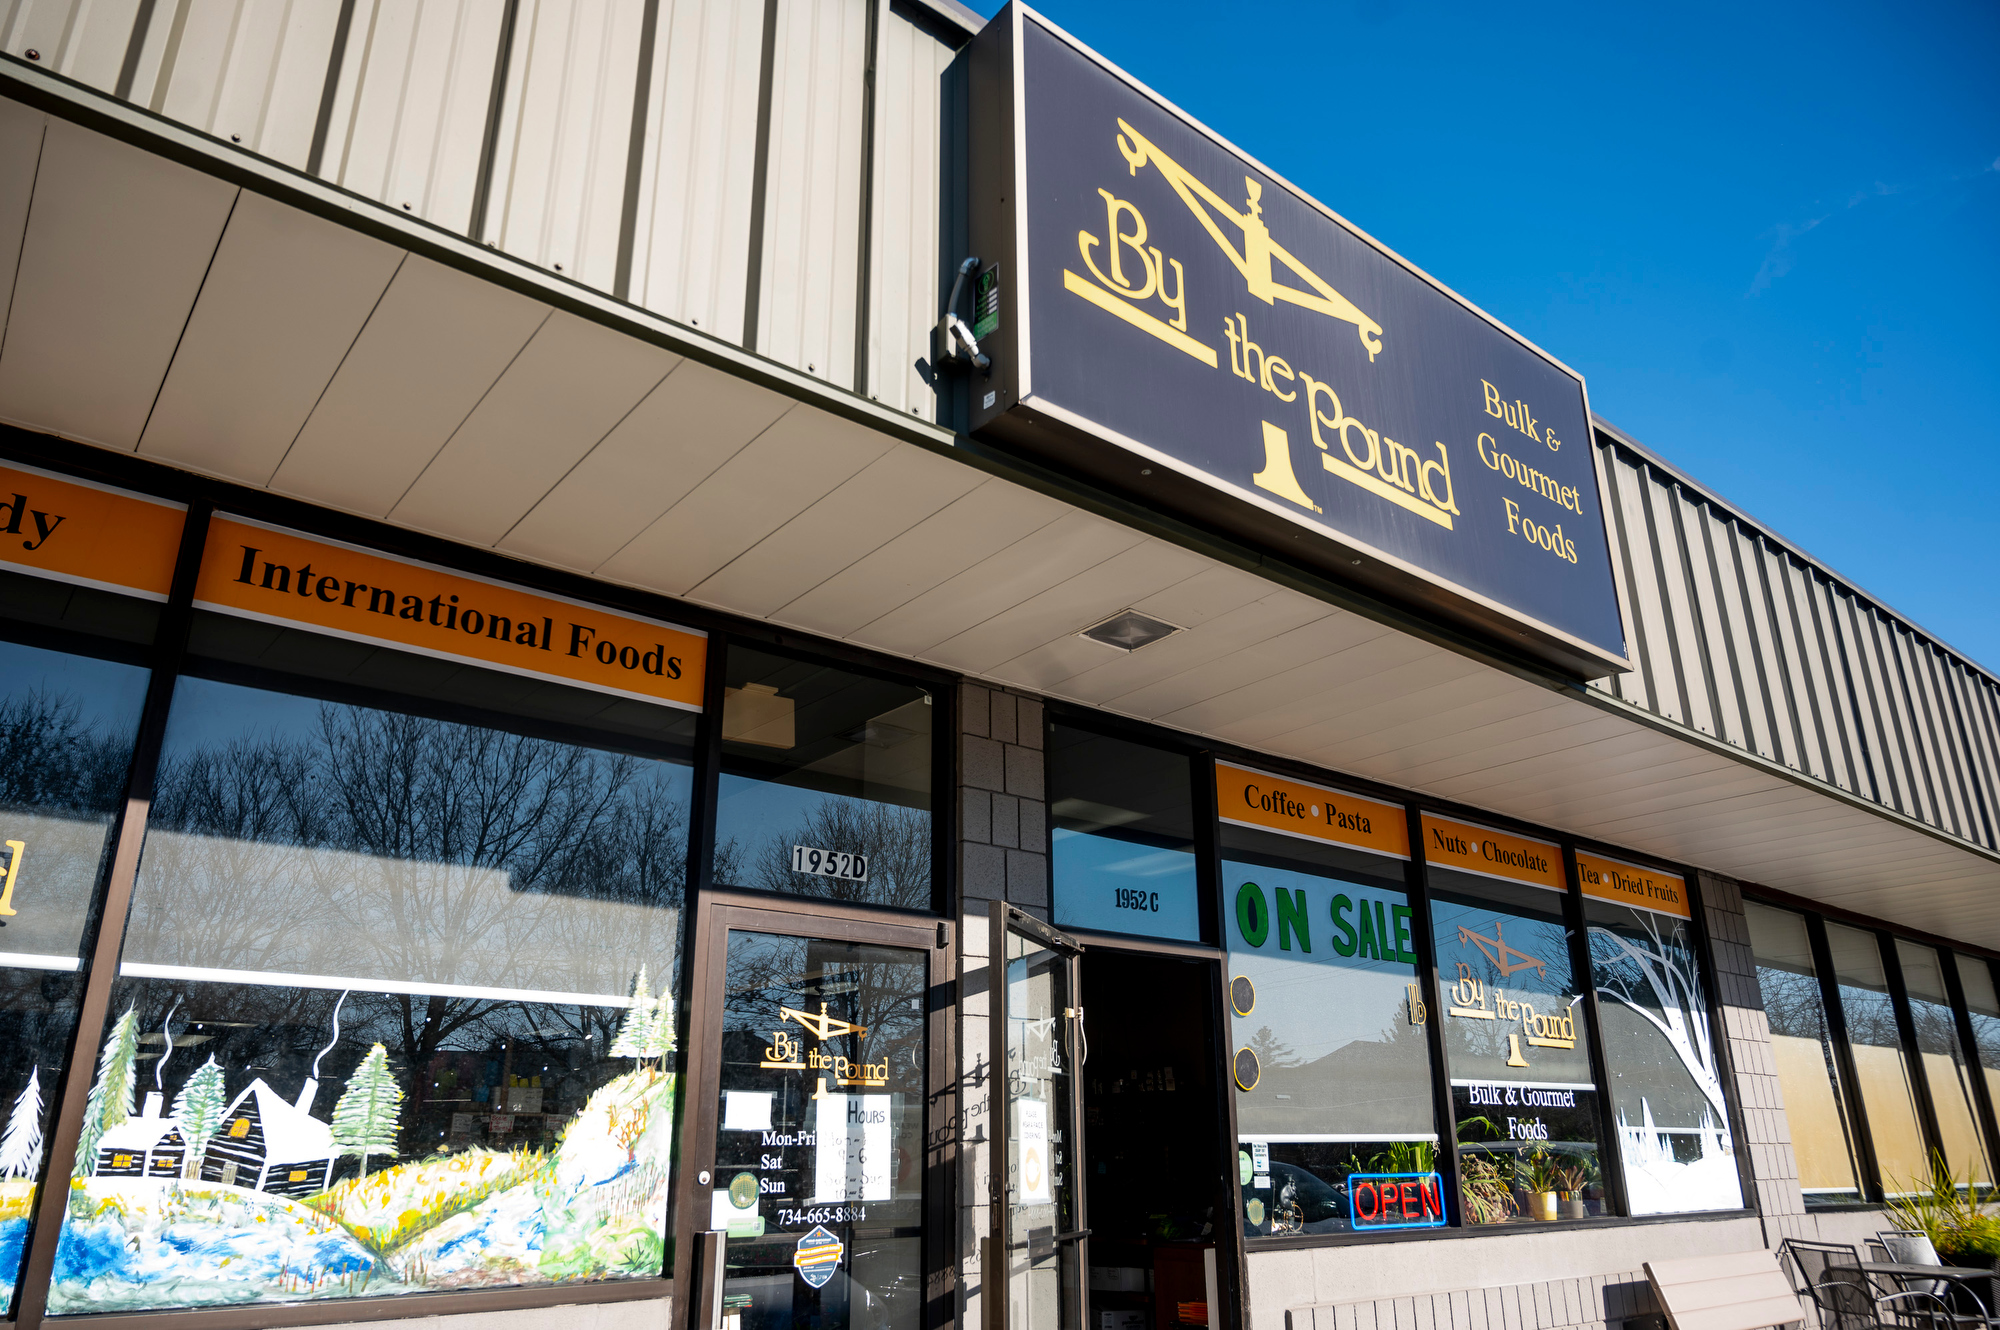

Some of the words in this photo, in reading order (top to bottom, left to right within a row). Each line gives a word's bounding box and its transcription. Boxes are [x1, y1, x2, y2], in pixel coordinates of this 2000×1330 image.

[1078, 187, 1187, 332] By
[1224, 312, 1297, 403] the
[1480, 378, 1542, 443] Bulk
[1546, 427, 1561, 452] &
[1299, 371, 1460, 516] Pound
[1477, 432, 1583, 515] Gourmet
[1502, 496, 1578, 564] Foods
[233, 545, 553, 651] International
[565, 622, 682, 680] Foods
[1244, 784, 1306, 819] Coffee
[1324, 802, 1372, 834] Pasta
[796, 847, 866, 878] 1952D
[1431, 828, 1468, 856] Nuts
[1482, 840, 1548, 874] Chocolate
[1114, 888, 1147, 911] 1952
[1577, 862, 1600, 885] Tea
[1611, 871, 1645, 896] Dried
[1645, 879, 1680, 904] Fruits
[1236, 882, 1311, 953] ON
[1330, 893, 1418, 965] SALE
[1452, 962, 1486, 1010] By
[1495, 988, 1520, 1021] the
[1520, 1002, 1577, 1040] Pound
[765, 1031, 799, 1063] By
[808, 1047, 833, 1069] the
[833, 1056, 889, 1080] Pound
[1468, 1083, 1502, 1105] Bulk
[1505, 1085, 1518, 1106] &
[1520, 1086, 1576, 1108] Gourmet
[761, 1130, 816, 1146] Mon-Fri
[1507, 1116, 1548, 1140] Foods
[760, 1153, 783, 1170] Sat
[760, 1177, 785, 1194] Sun
[1355, 1182, 1440, 1221] OPEN
[777, 1206, 866, 1226] 734-665-8884
